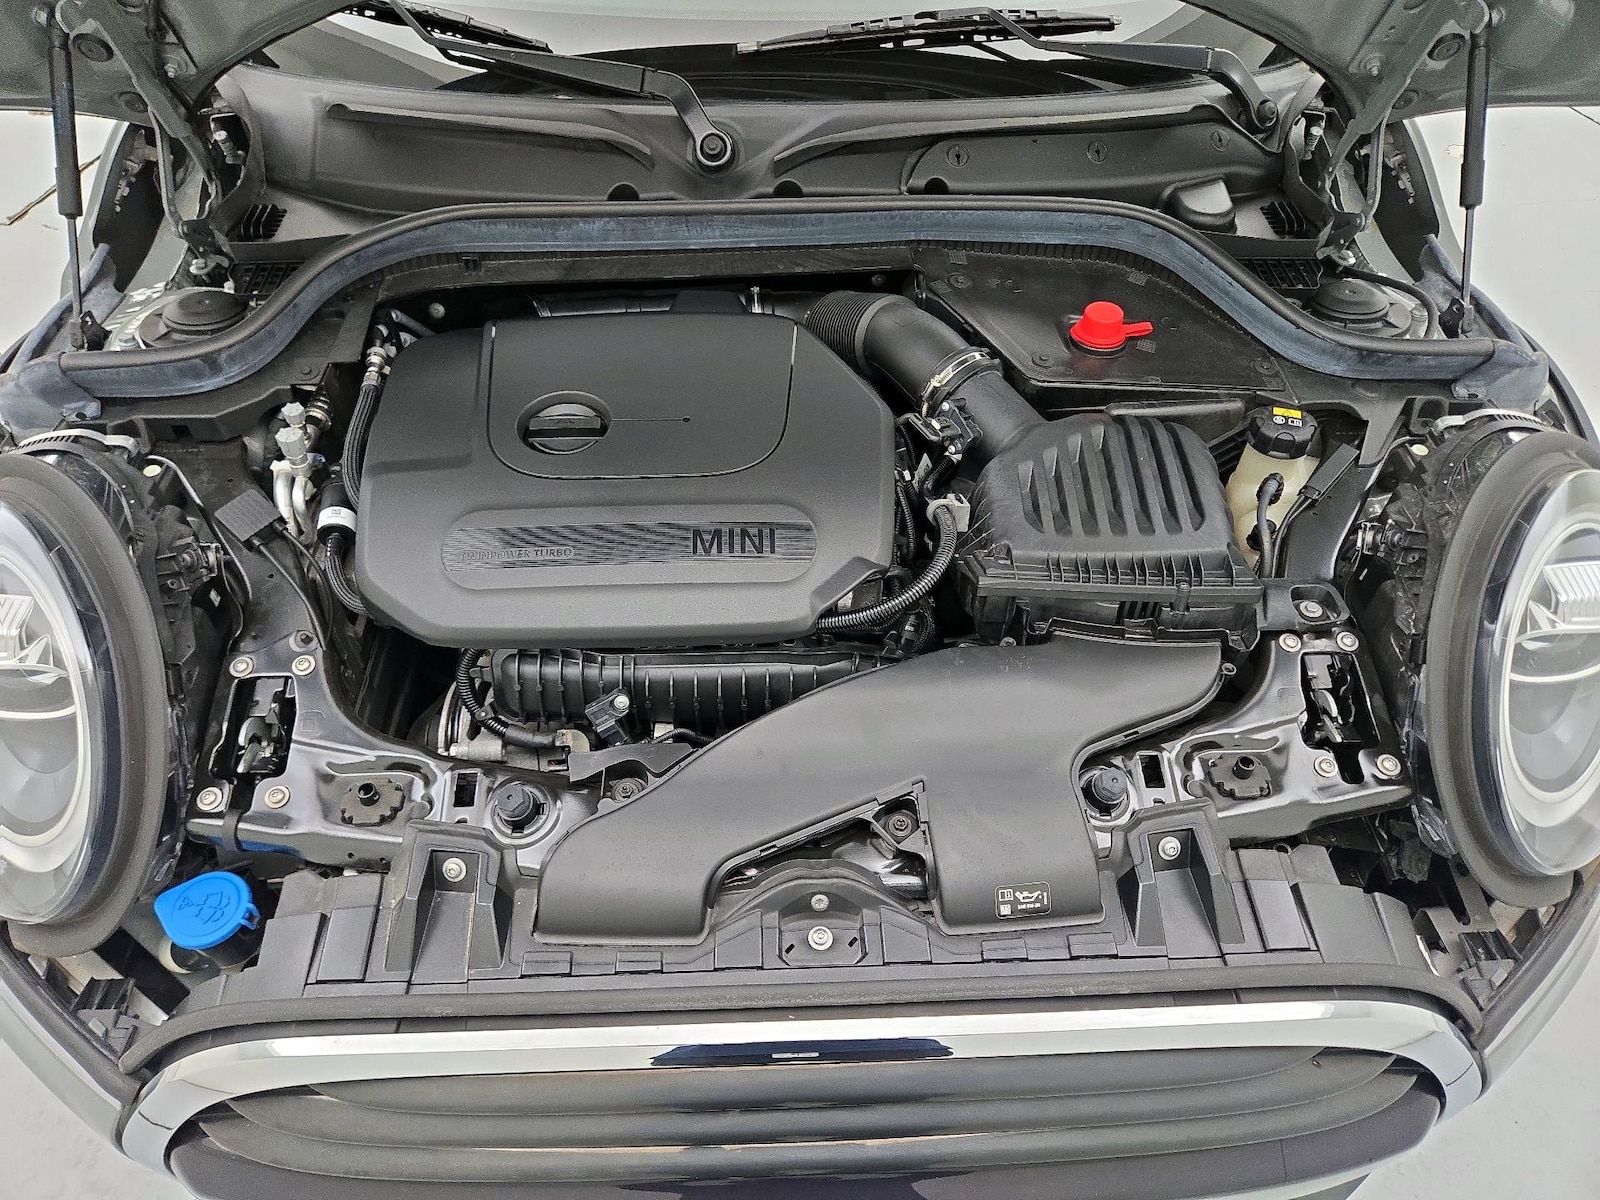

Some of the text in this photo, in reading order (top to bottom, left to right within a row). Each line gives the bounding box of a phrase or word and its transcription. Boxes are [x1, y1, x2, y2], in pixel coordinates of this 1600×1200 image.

[693, 528, 776, 554] MINI
[460, 547, 573, 561] TWINPOWER TURBO
